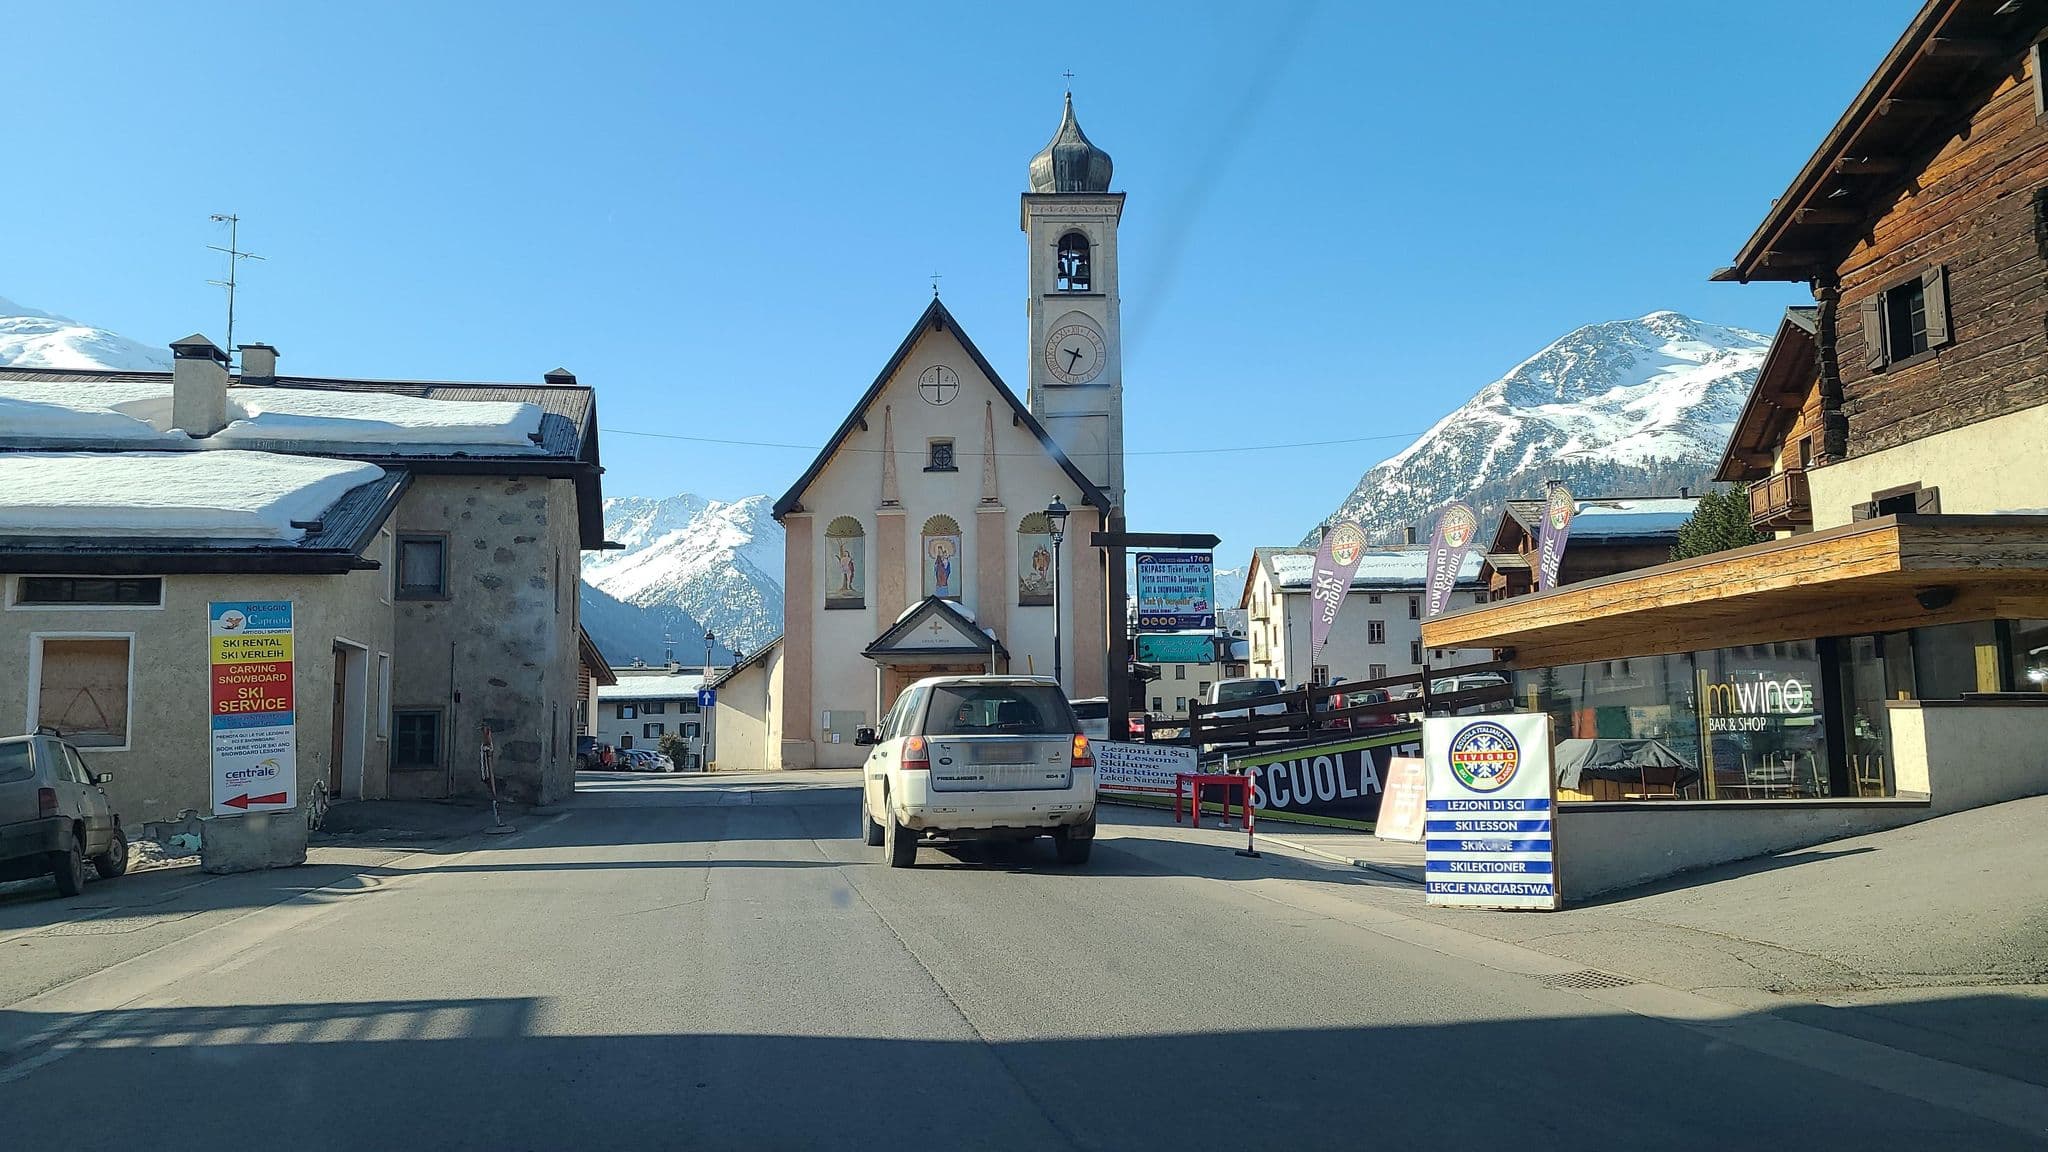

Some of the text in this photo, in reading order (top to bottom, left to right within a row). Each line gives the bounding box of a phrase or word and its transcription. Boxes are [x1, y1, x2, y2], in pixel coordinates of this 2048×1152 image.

[1541, 536, 1555, 574] BOOK
[1442, 553, 1462, 593] SCHOOL
[1546, 551, 1561, 588] HERE
[1314, 569, 1334, 601] SKI
[1429, 548, 1447, 617] NOWBOARD
[1322, 578, 1345, 625] SCHOOL
[222, 638, 282, 648] SKI RENTAL
[221, 650, 284, 659] SKI VERLEIH
[229, 664, 277, 674] CARVING
[218, 673, 287, 684] SNOWBOARD
[237, 686, 264, 699] SKI
[1706, 672, 1804, 714] miwine
[218, 697, 287, 713] SERVICE
[1709, 717, 1767, 731] BAR & SHOP
[1101, 745, 1150, 755] Lezioni
[1100, 752, 1178, 764] Ski Lessons
[1455, 753, 1514, 761] LIVIGNO
[1100, 759, 1160, 770] Skikurse
[225, 767, 275, 779] centrale
[1099, 774, 1132, 782] Lekcje
[1100, 767, 1177, 777] Skilektione
[1244, 749, 1382, 810] SCUOLA
[1447, 800, 1525, 811] LEZIONI DI SCI
[1455, 821, 1518, 831] SKI LESSON
[1450, 862, 1526, 873] SKILEKTIONER
[1429, 883, 1550, 895] LEKCJE NARCIARSTWA
